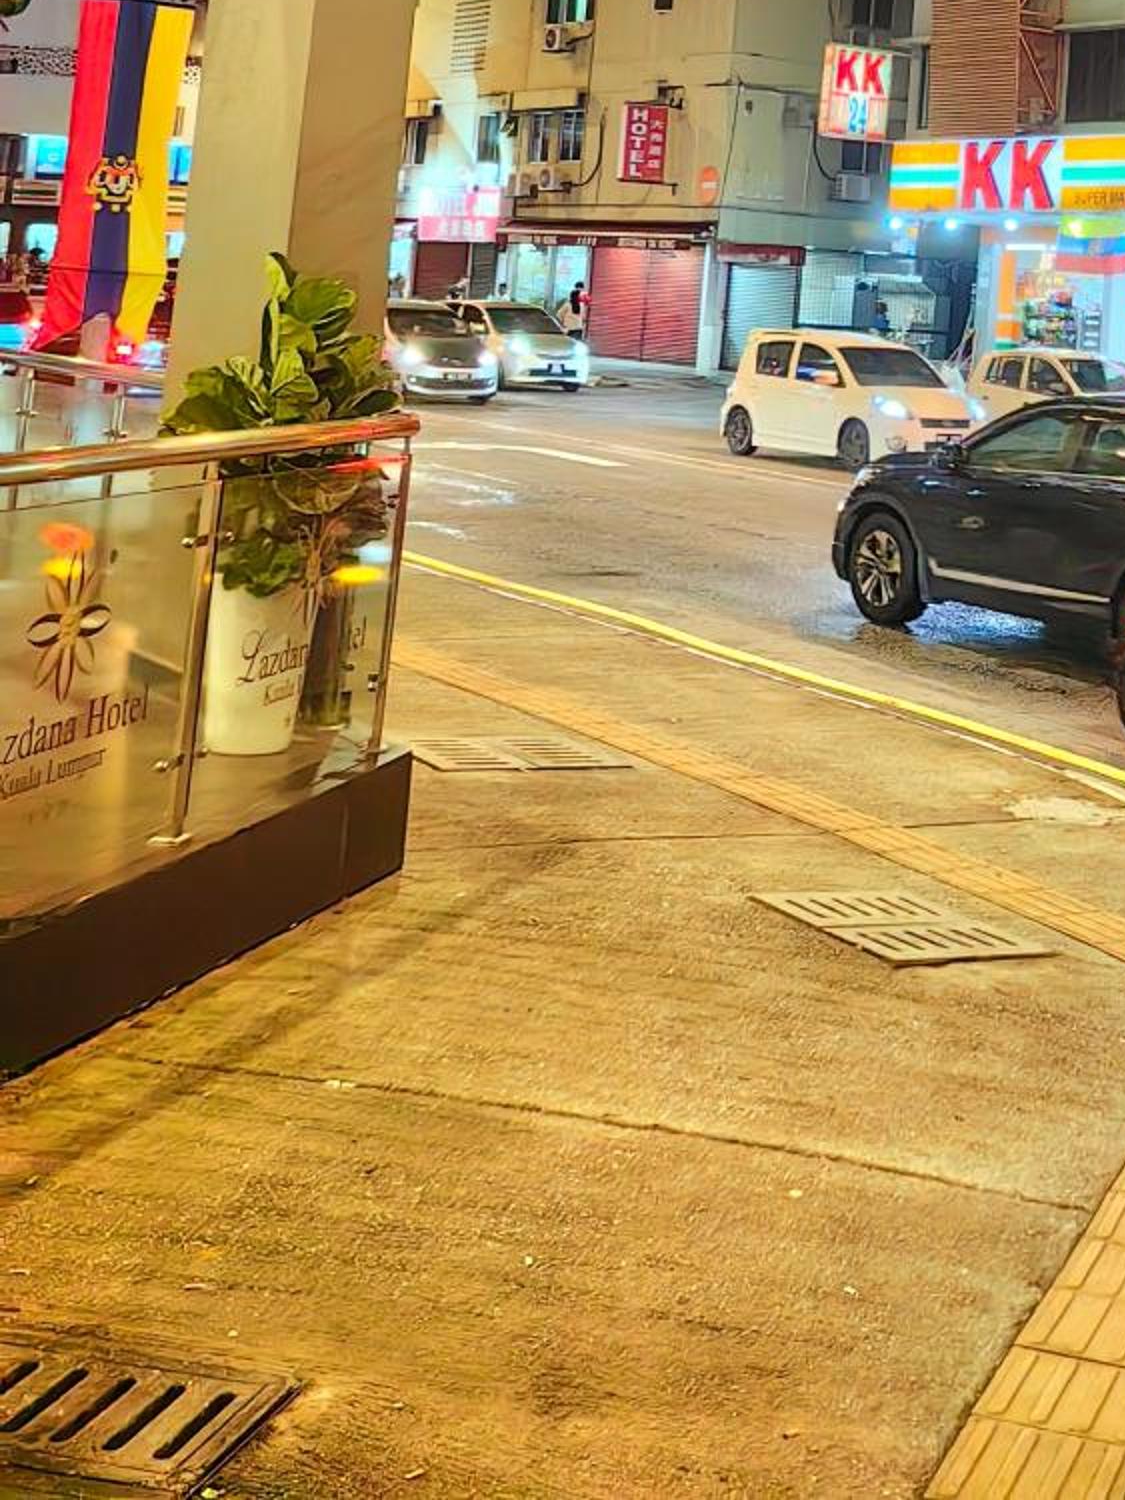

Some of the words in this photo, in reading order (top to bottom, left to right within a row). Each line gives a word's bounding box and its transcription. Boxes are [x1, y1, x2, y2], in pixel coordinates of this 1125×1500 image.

[835, 48, 886, 94] KK
[629, 108, 649, 177] HOTEL
[961, 139, 1057, 211] KK
[84, 683, 149, 739] Hotel
